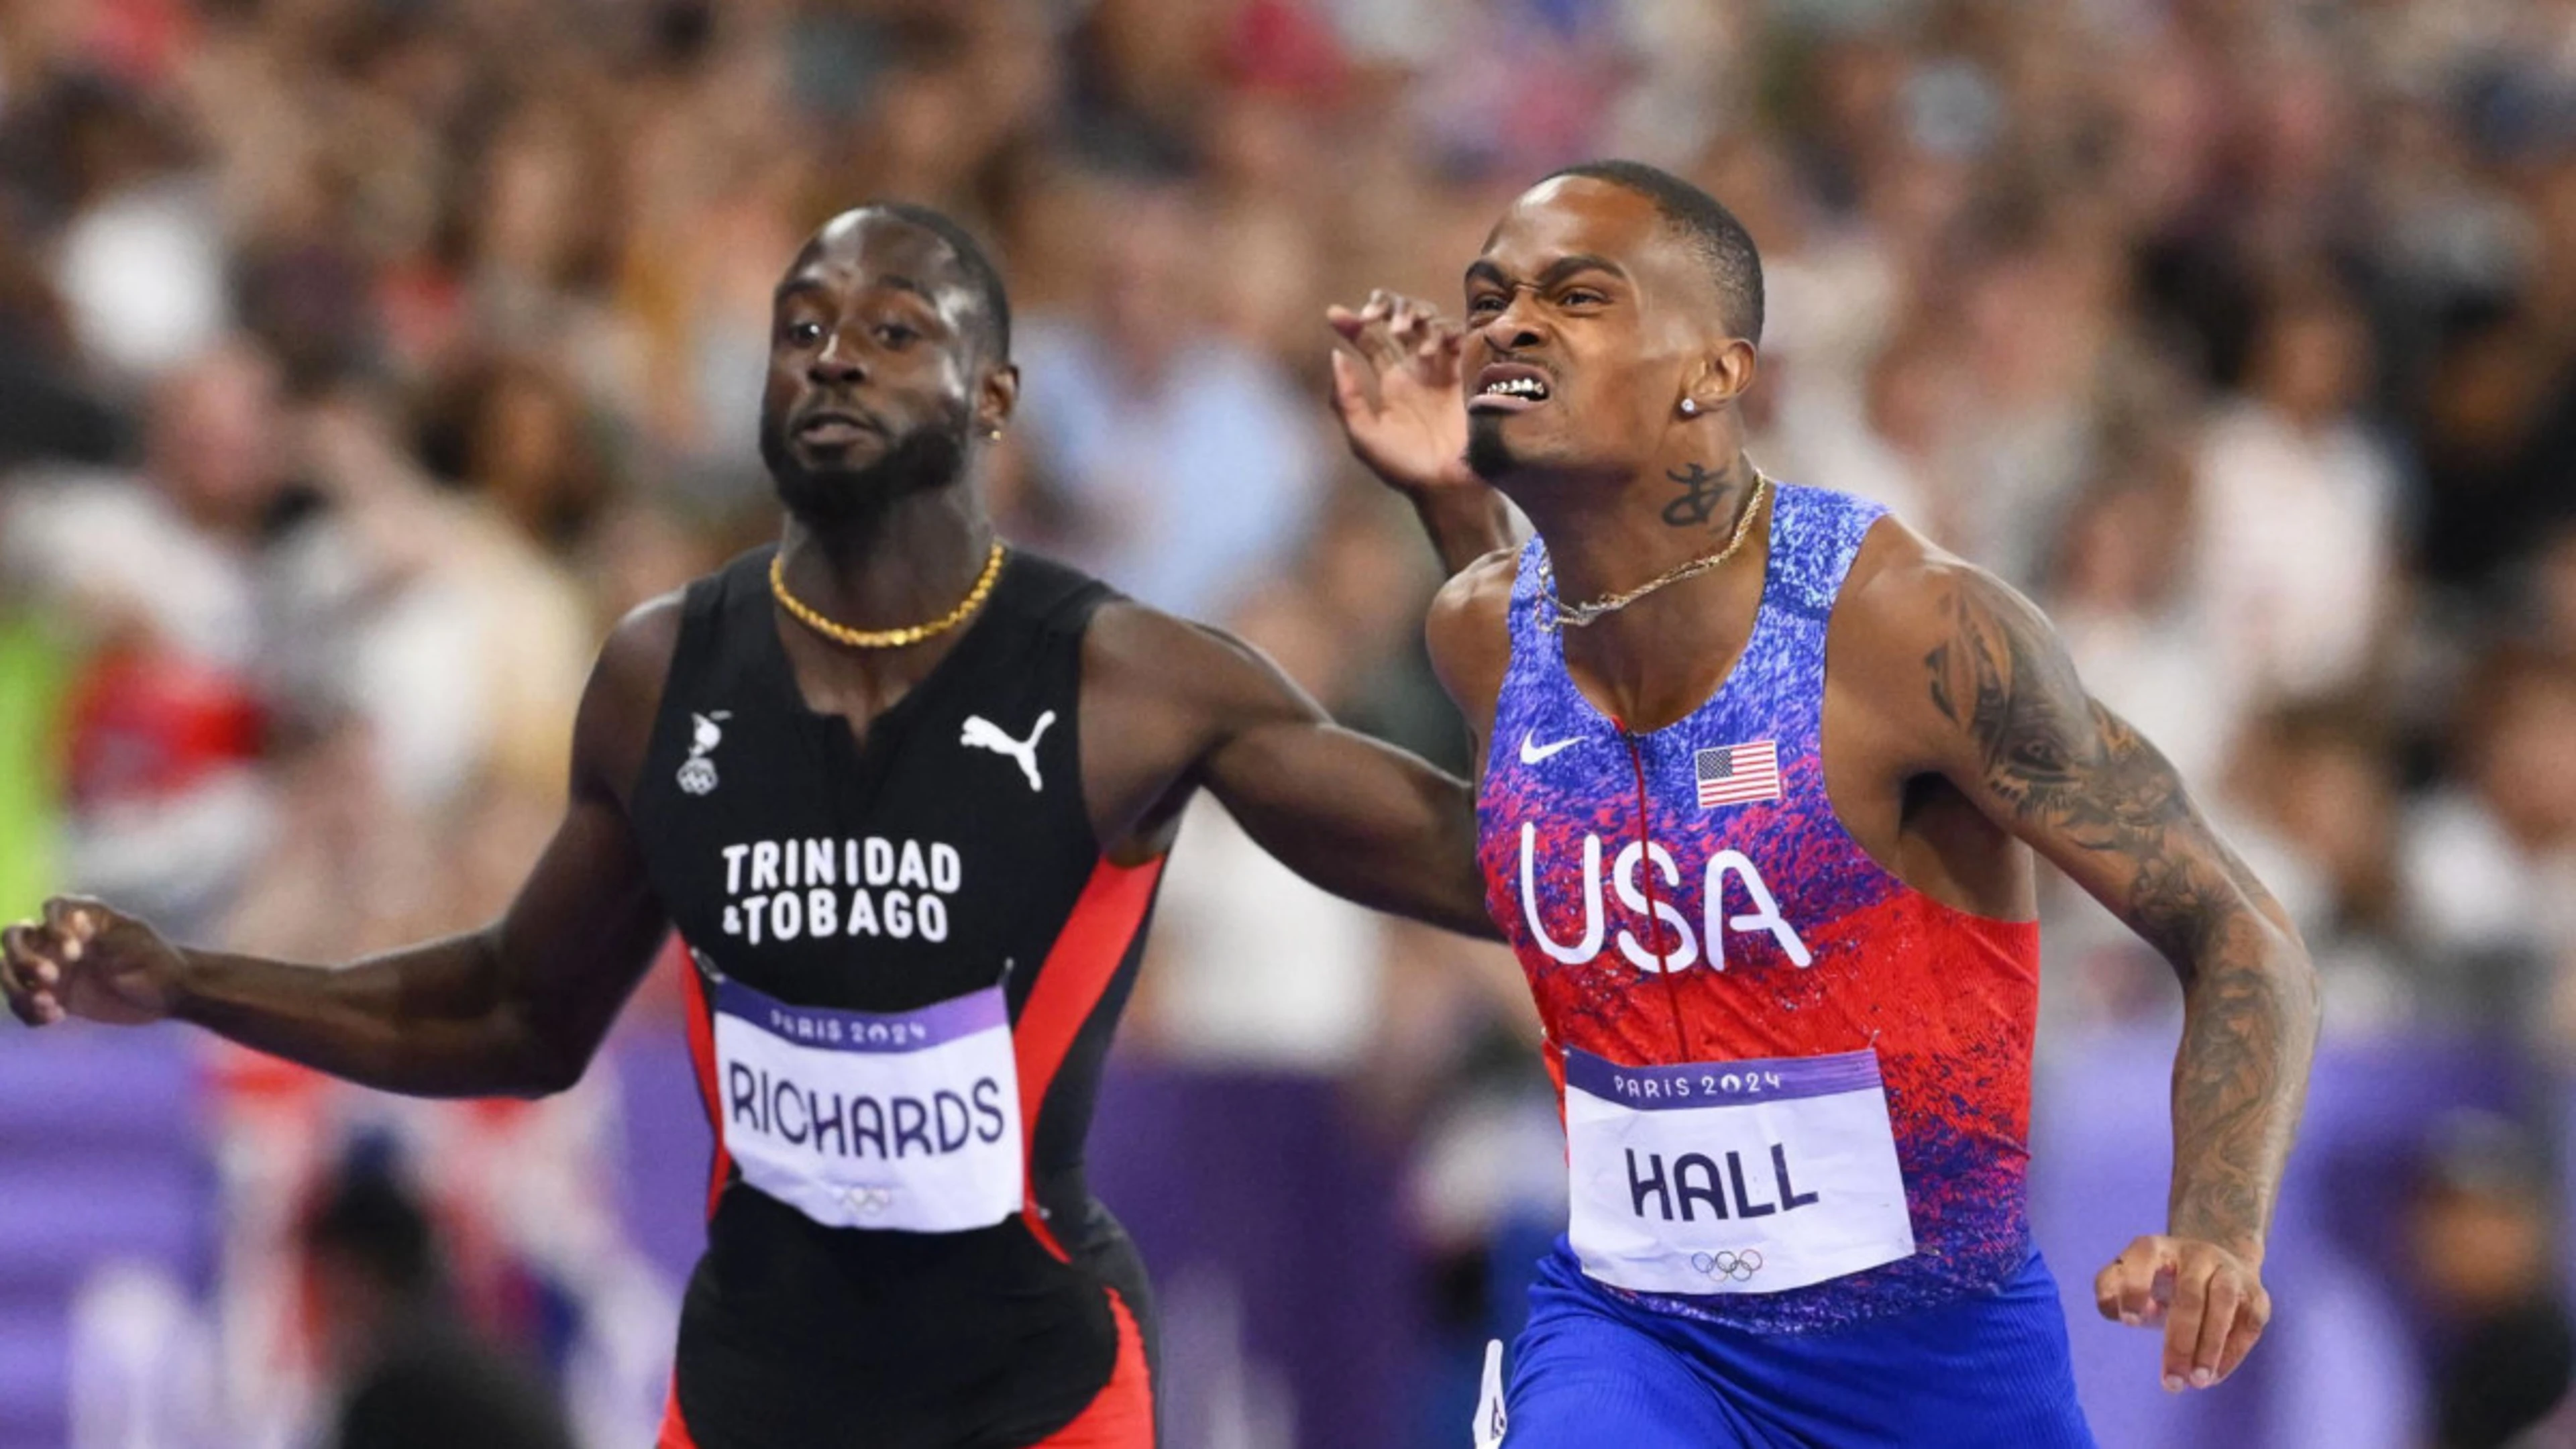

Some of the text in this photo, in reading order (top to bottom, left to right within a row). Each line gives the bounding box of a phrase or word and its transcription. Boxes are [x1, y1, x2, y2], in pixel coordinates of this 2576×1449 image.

[721, 837, 961, 894] TRINIDAD
[1519, 821, 1812, 974] USA
[722, 888, 947, 945] &TOBAGO
[729, 1061, 1005, 1160] RICHARDS
[1701, 1071, 1780, 1095] 2024
[1625, 1143, 1819, 1222] HALL
